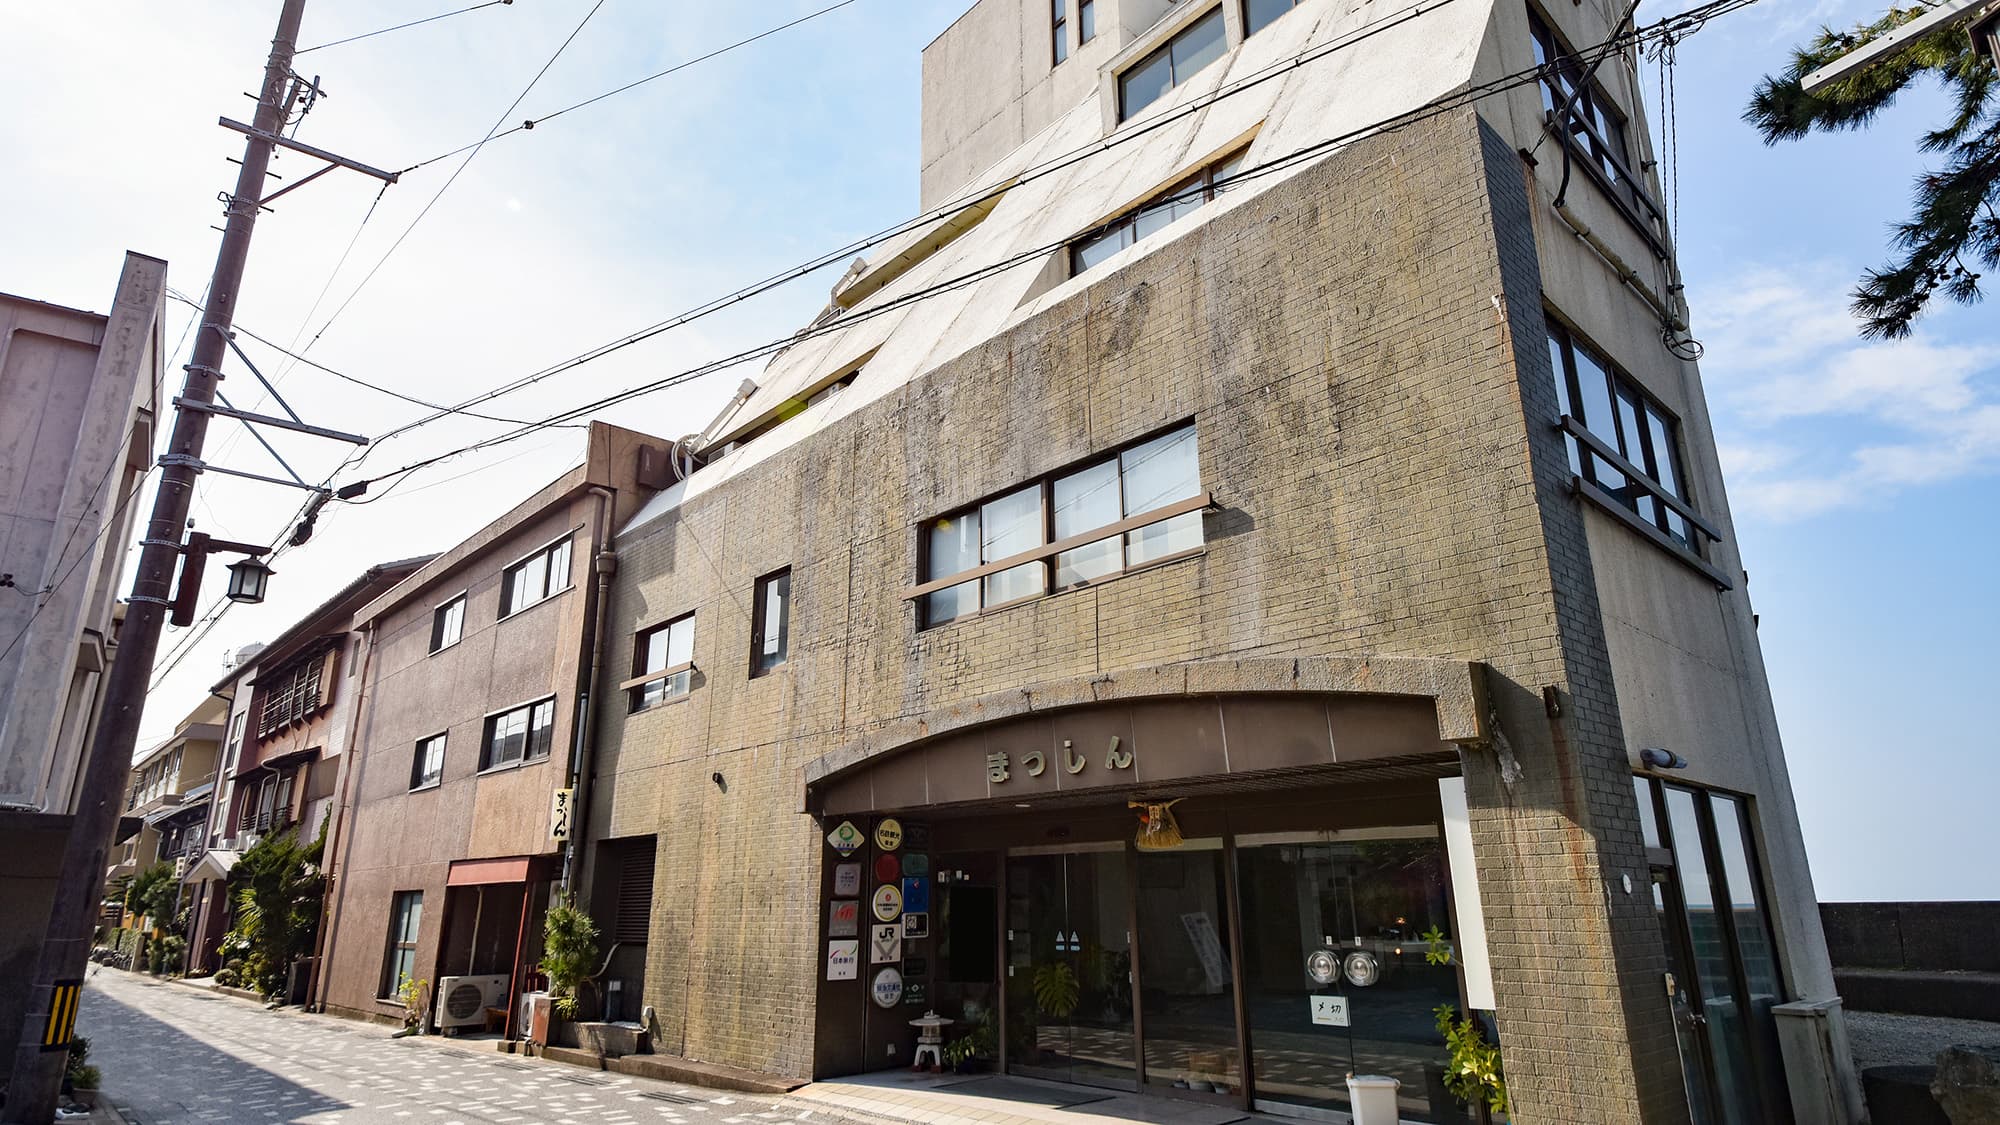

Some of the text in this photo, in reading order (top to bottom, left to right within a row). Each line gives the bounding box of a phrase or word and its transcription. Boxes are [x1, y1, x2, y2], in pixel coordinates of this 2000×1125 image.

[879, 927, 895, 939] JR
[832, 957, 854, 965] 日本旅行
